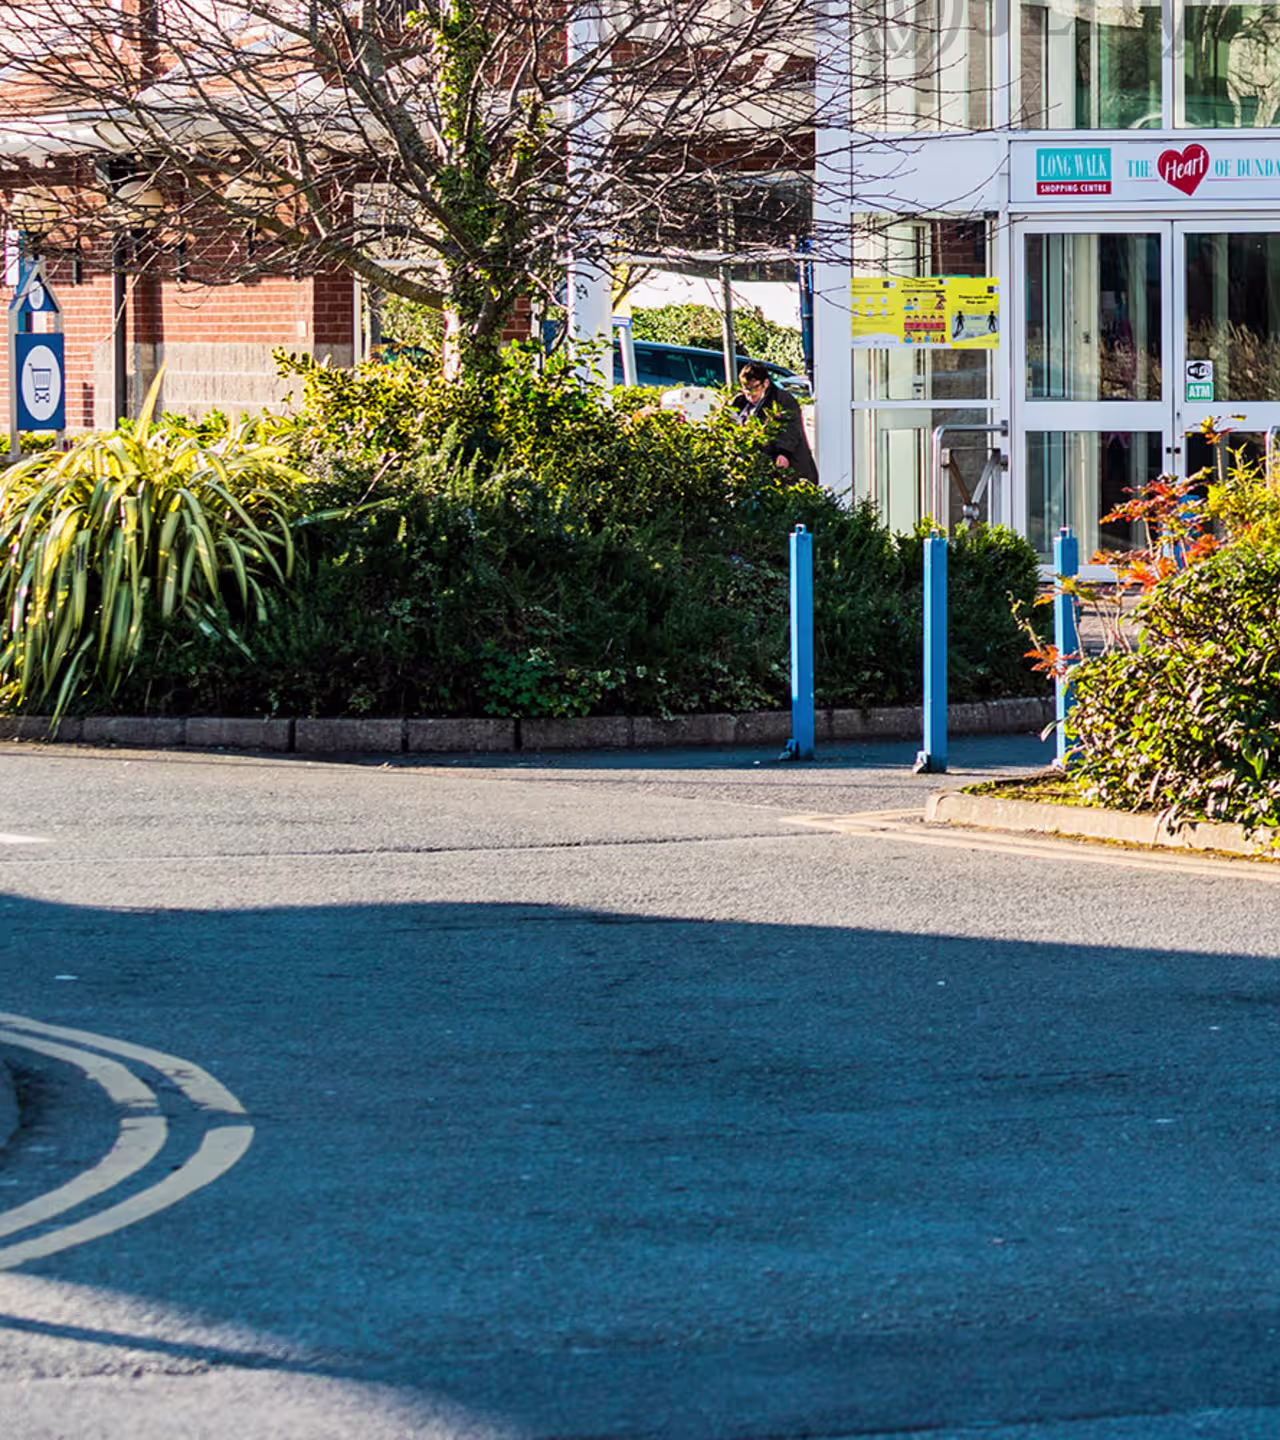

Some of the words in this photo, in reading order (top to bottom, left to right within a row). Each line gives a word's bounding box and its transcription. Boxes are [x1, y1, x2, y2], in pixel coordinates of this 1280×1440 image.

[1041, 154, 1071, 176] LONG
[1075, 154, 1107, 176] WALK
[1127, 160, 1153, 178] THE
[1164, 150, 1206, 182] Heart
[1215, 160, 1232, 178] OF
[1041, 183, 1078, 193] SHOPPING
[1080, 183, 1107, 193] CENTRE
[1189, 385, 1211, 398] ATM
